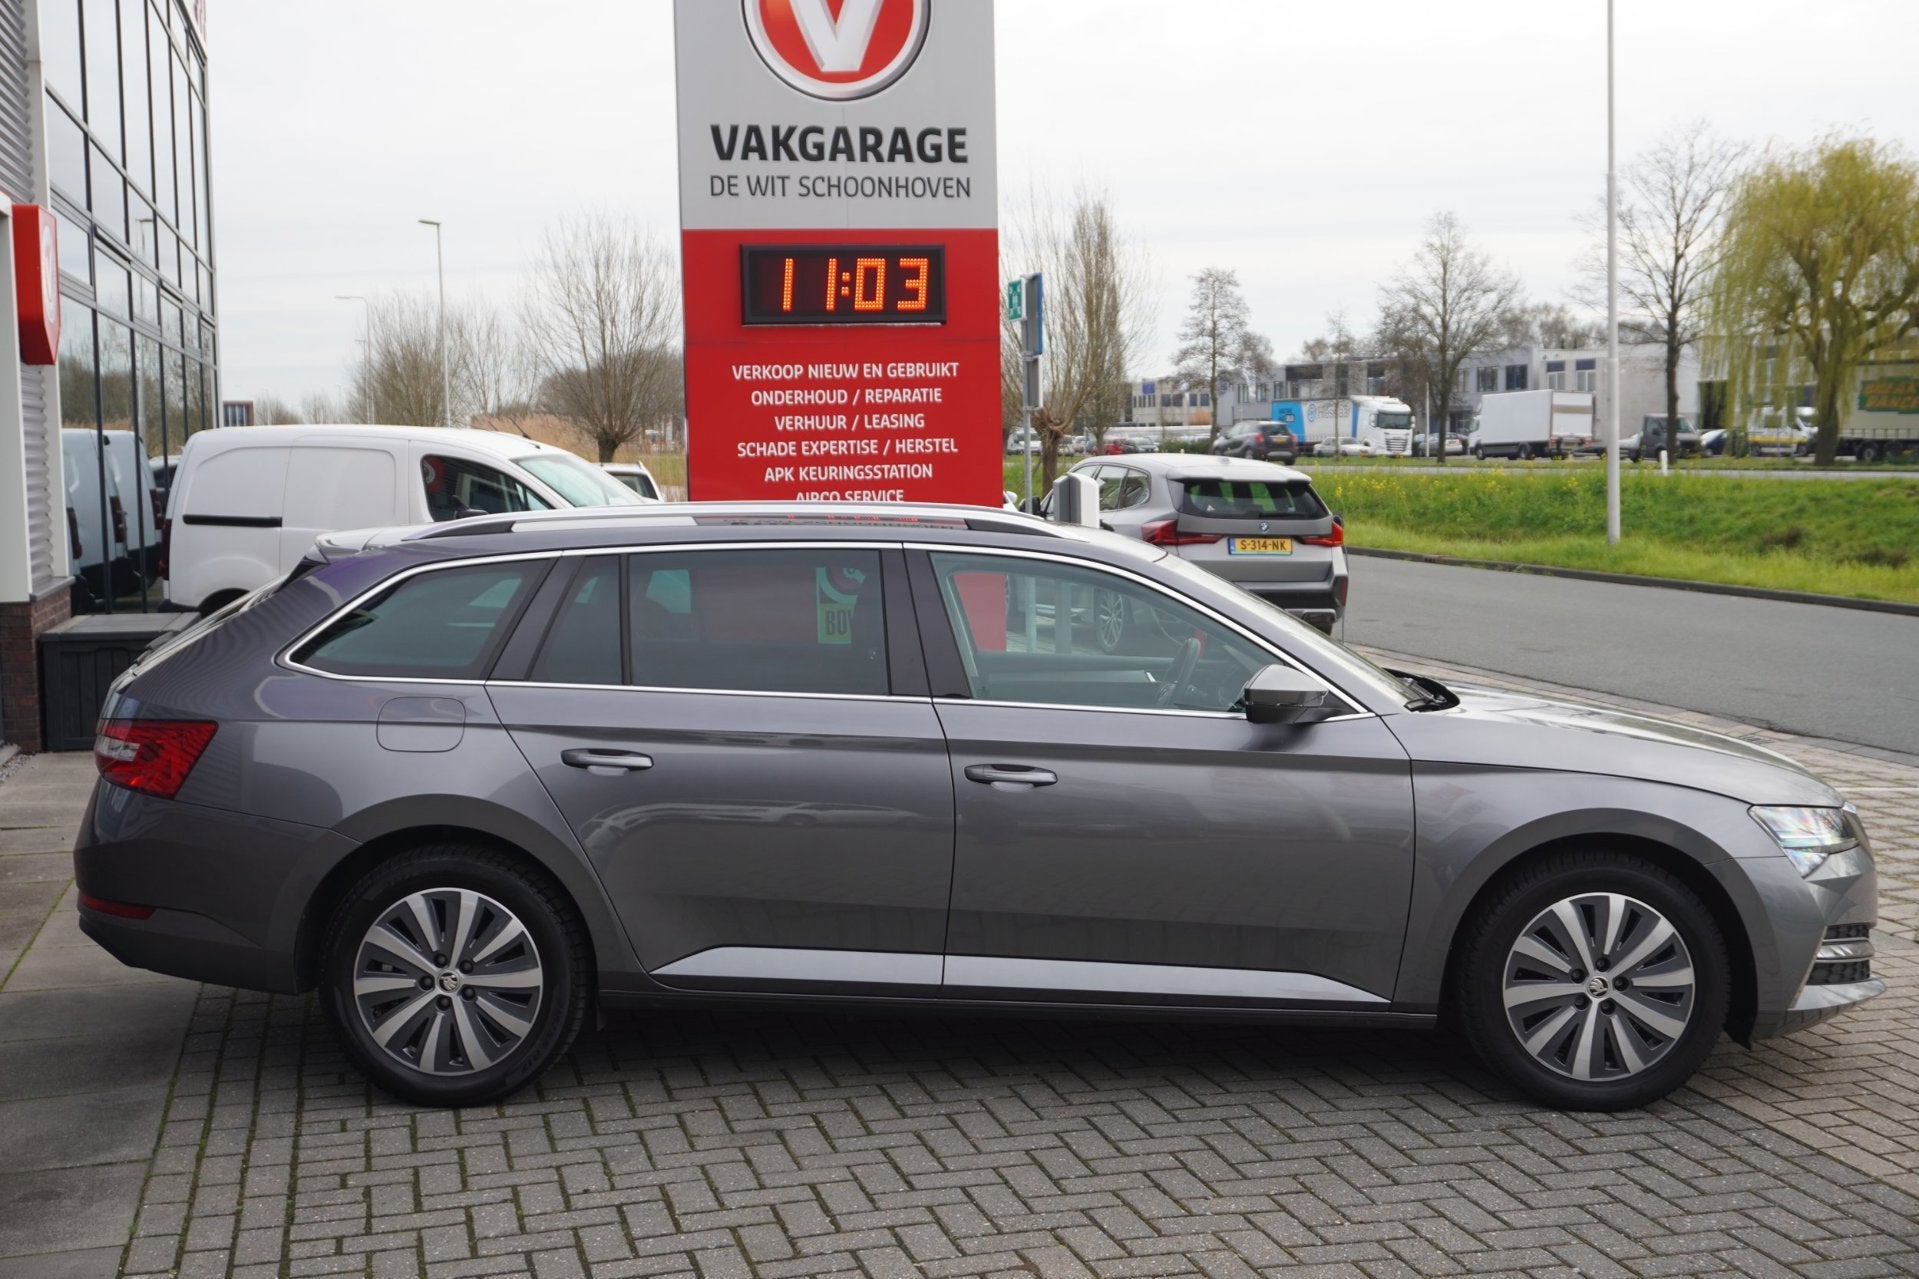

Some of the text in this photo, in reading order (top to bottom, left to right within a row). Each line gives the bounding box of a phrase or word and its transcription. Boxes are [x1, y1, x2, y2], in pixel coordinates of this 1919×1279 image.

[789, 0, 882, 72] V
[710, 124, 969, 164] VAKGARAGE
[709, 175, 971, 198] DE WIT SCHOONHOVEN
[732, 362, 959, 380] VERKOOP NIEUW EN GEBRUIKT
[751, 389, 848, 405] ONDERHOUD
[865, 388, 942, 404] REPARATIE
[775, 415, 847, 431] VERHUUR
[864, 413, 925, 429] LEASING
[737, 441, 797, 457] SCHADE
[801, 440, 878, 456] EXPERTISE
[895, 438, 958, 454] HERSTEL
[764, 464, 933, 482] APK KEURINGSSTATION
[796, 489, 905, 502] AIRCO SERVICE
[1240, 539, 1287, 551] S-314-NK
